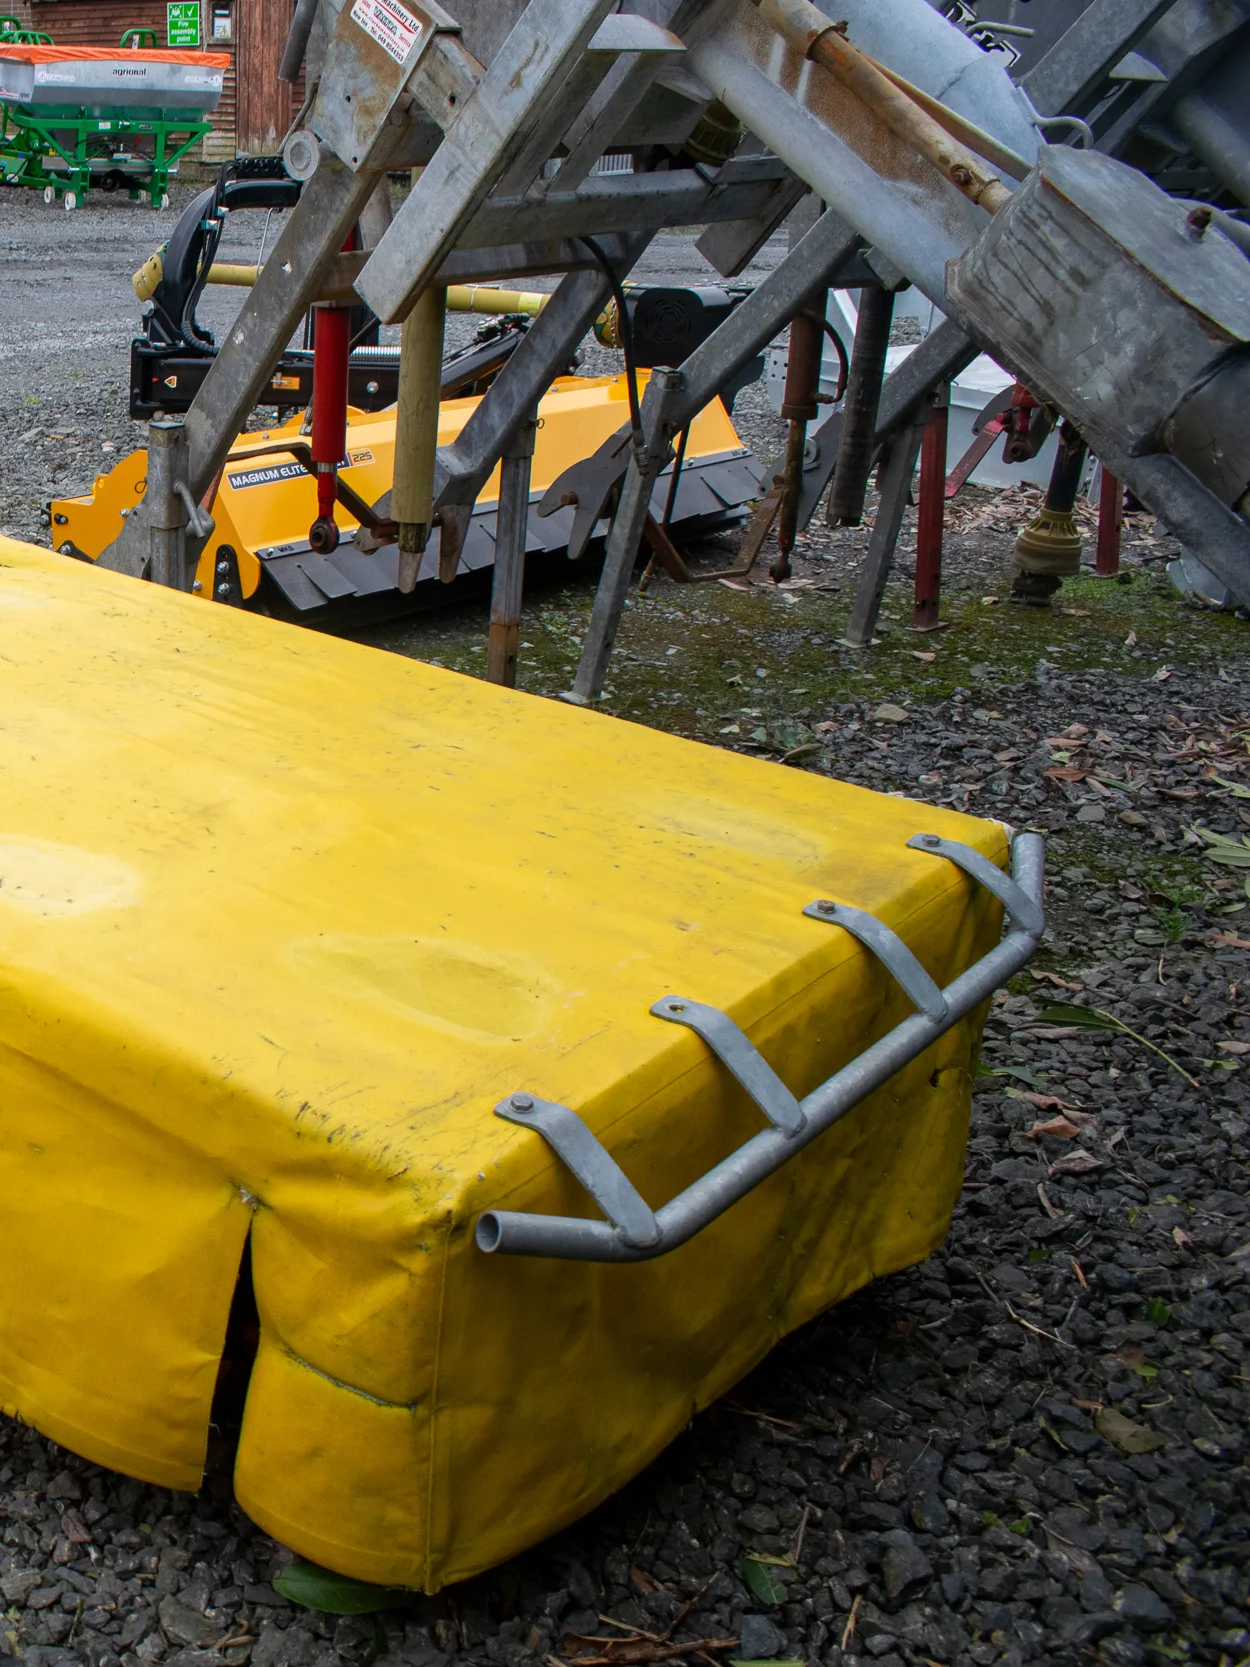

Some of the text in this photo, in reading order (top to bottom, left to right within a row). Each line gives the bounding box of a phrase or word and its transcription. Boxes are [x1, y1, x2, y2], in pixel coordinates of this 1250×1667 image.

[171, 28, 196, 36] assembly
[177, 35, 190, 43] point
[112, 68, 147, 76] agrional
[352, 451, 372, 463] 225
[231, 464, 308, 488] MAGNUM ELITE
